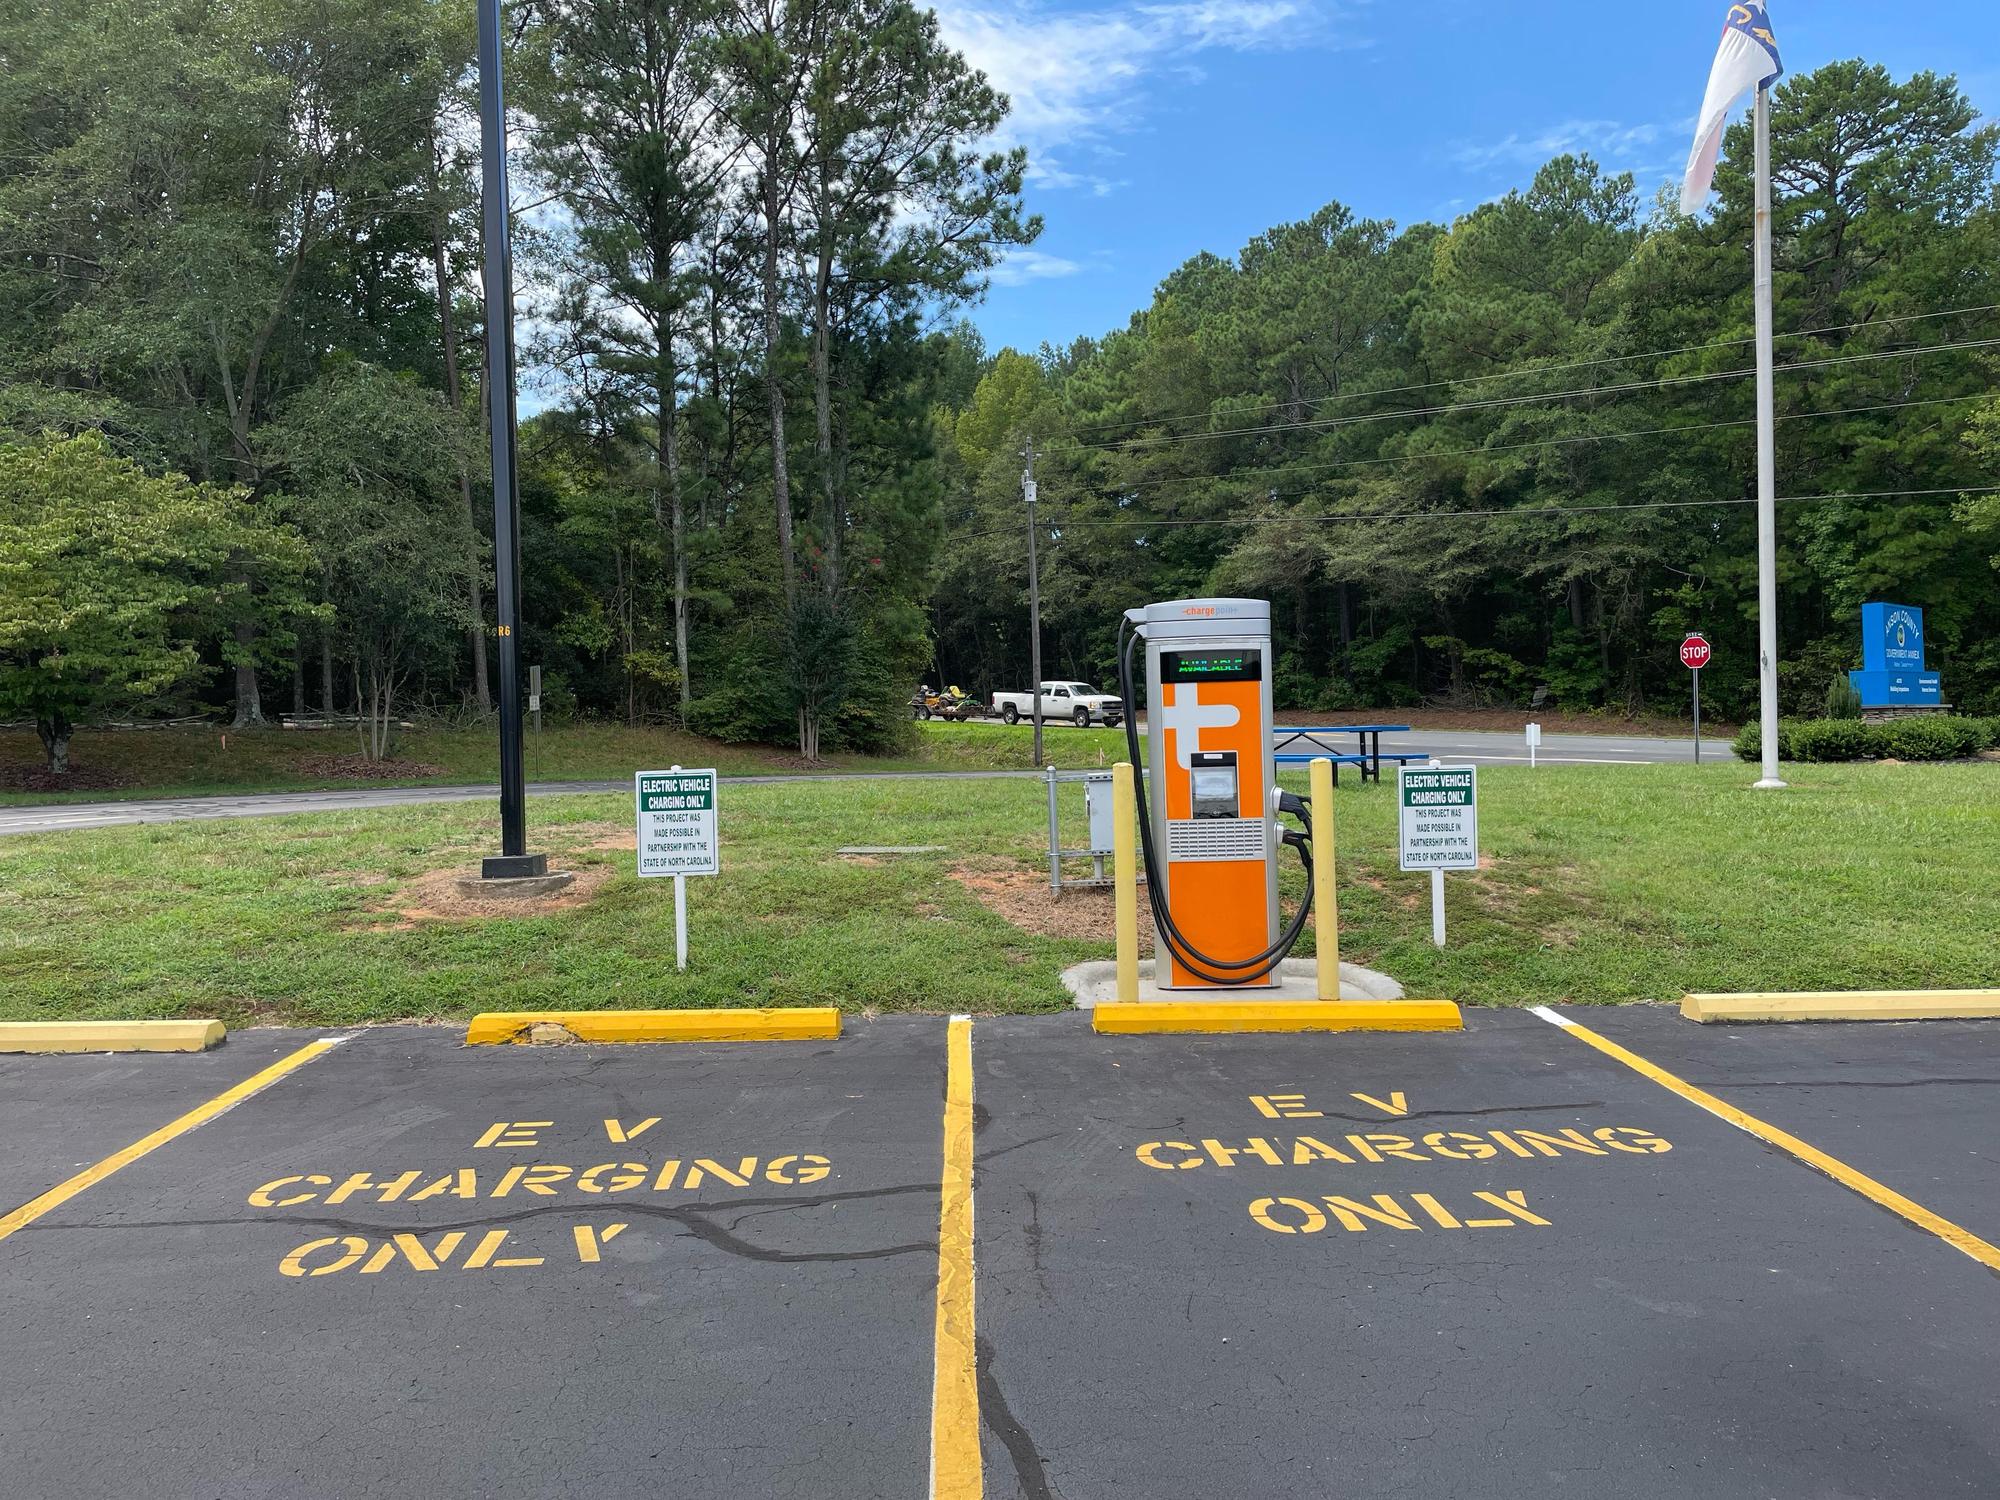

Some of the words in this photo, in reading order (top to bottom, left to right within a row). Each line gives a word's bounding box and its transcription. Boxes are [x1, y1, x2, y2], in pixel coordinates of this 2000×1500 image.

[498, 625, 511, 636] R6
[1901, 610, 1920, 639] COUNTY
[1682, 646, 1708, 659] STOP
[642, 779, 678, 793] ELECTRIC
[679, 778, 710, 792] VEHICLE
[1405, 775, 1440, 788] ELECTRIC
[1440, 774, 1471, 787] VEHICLE
[648, 795, 685, 809] CHARGING
[686, 795, 705, 808] ONLY
[1411, 791, 1446, 804] CHARGING
[1447, 791, 1466, 803] ONLY
[653, 814, 665, 823] THIS
[665, 813, 689, 823] PROJECT
[689, 813, 701, 822] WAS
[1415, 810, 1427, 818] THIS
[1427, 809, 1450, 818] PROJECT
[1450, 808, 1461, 817] WAS
[654, 828, 668, 838] MADE
[669, 828, 694, 837] POSSIBLE
[694, 827, 700, 837] IN
[1416, 823, 1430, 833] MADE
[1431, 823, 1455, 832] POSSIBLE
[1455, 823, 1461, 832] IN
[647, 843, 682, 853] PARTNERSHIP
[682, 842, 697, 851] WITH
[697, 842, 707, 851] THE
[1410, 838, 1444, 847] PARTNERSHIP
[1444, 837, 1457, 846] WITH
[1457, 837, 1468, 846] THE
[643, 858, 660, 868] STATE
[660, 858, 667, 867] OF
[667, 857, 685, 867] NORTH
[686, 856, 712, 866] CAROLINA
[1406, 853, 1422, 862] STATE
[1422, 853, 1429, 862] OF
[1430, 852, 1447, 861] NORTH
[1447, 852, 1472, 861] CAROLINA
[1248, 1094, 1324, 1119] E
[1349, 1091, 1409, 1116] V
[473, 1120, 553, 1149] E
[603, 1117, 663, 1143] V
[1135, 1126, 1674, 1170] CHARGING
[248, 1154, 832, 1208] CHARGING
[1247, 1189, 1553, 1234] ONLY
[278, 1222, 629, 1277] ONLY
